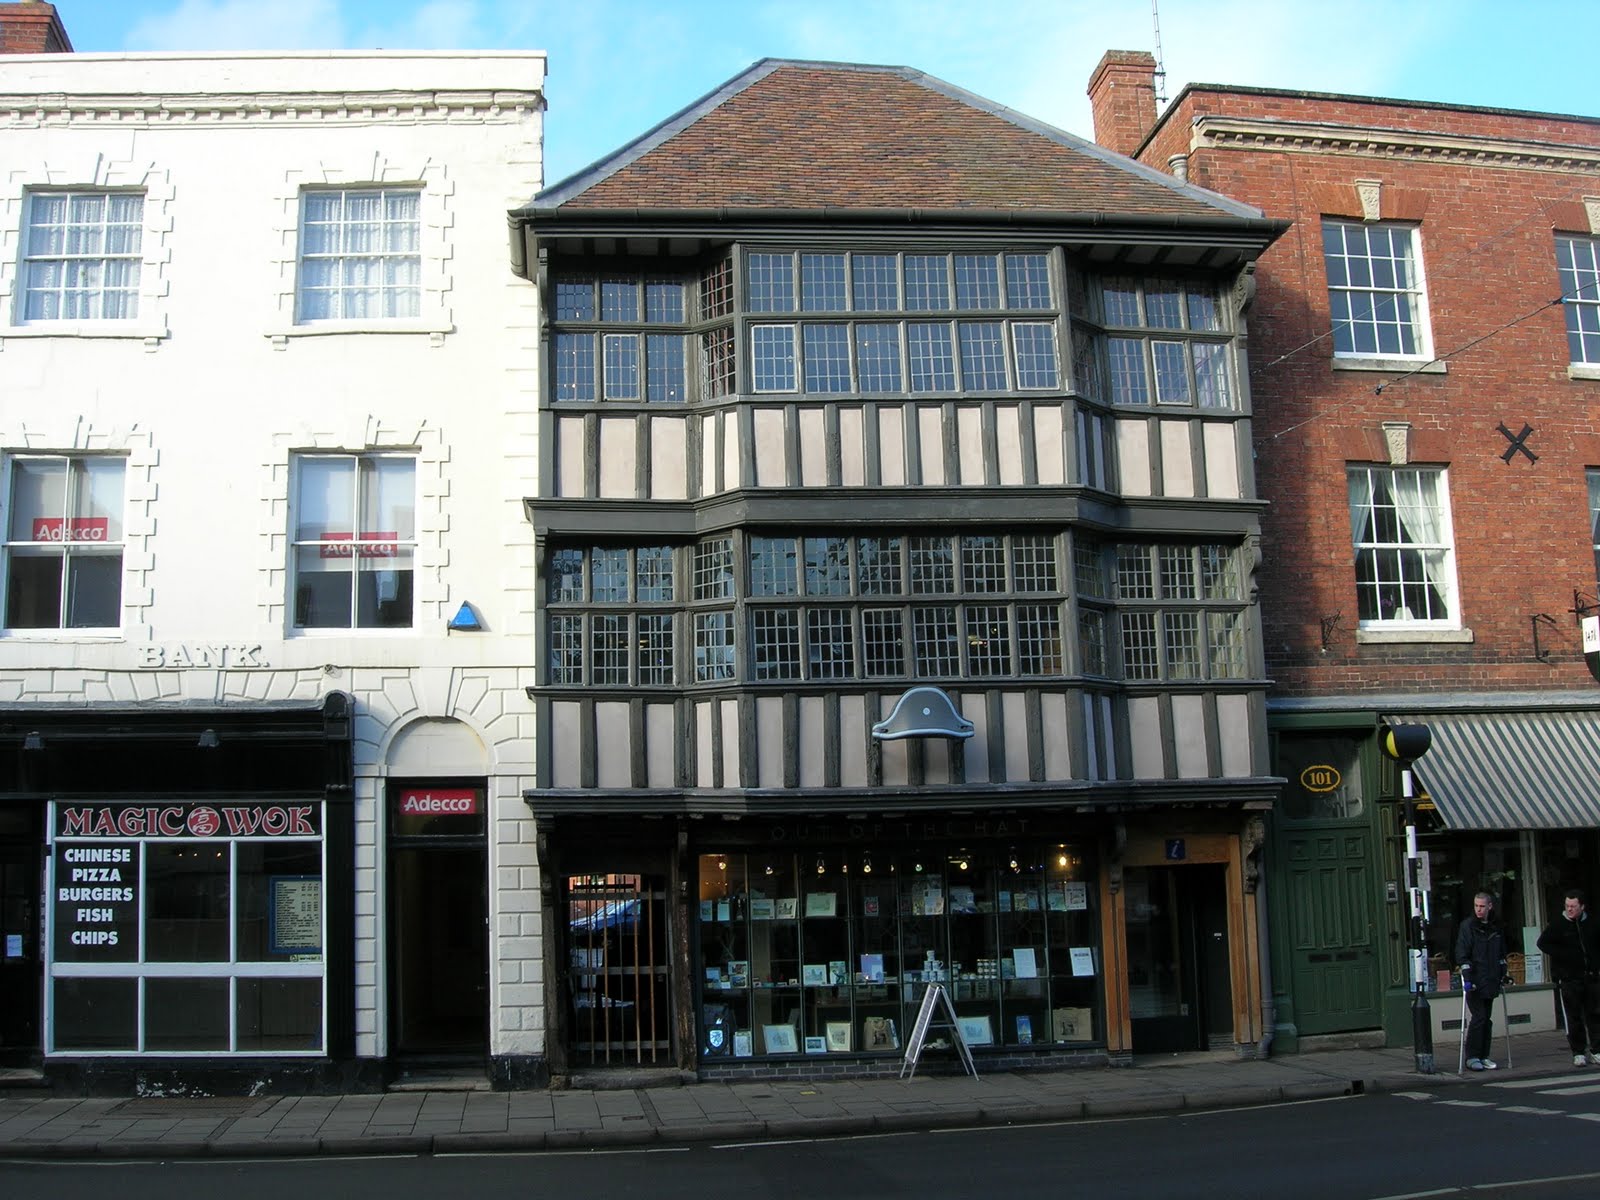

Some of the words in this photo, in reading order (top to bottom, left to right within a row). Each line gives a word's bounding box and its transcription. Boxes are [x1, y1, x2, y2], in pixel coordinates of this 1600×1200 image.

[36, 524, 104, 540] Adecco
[324, 538, 395, 555] Adcco
[1309, 771, 1332, 785] 101
[404, 793, 472, 811] Adecco
[63, 807, 185, 836] MAGIC
[222, 806, 315, 836] WOK
[850, 823, 881, 840] OF
[974, 819, 1029, 835] HAT
[64, 848, 131, 863] CHINESE
[72, 868, 121, 882] PIZZA
[59, 887, 134, 901] BURGERS
[77, 908, 113, 922] FISH
[71, 931, 118, 945] CHIPS
